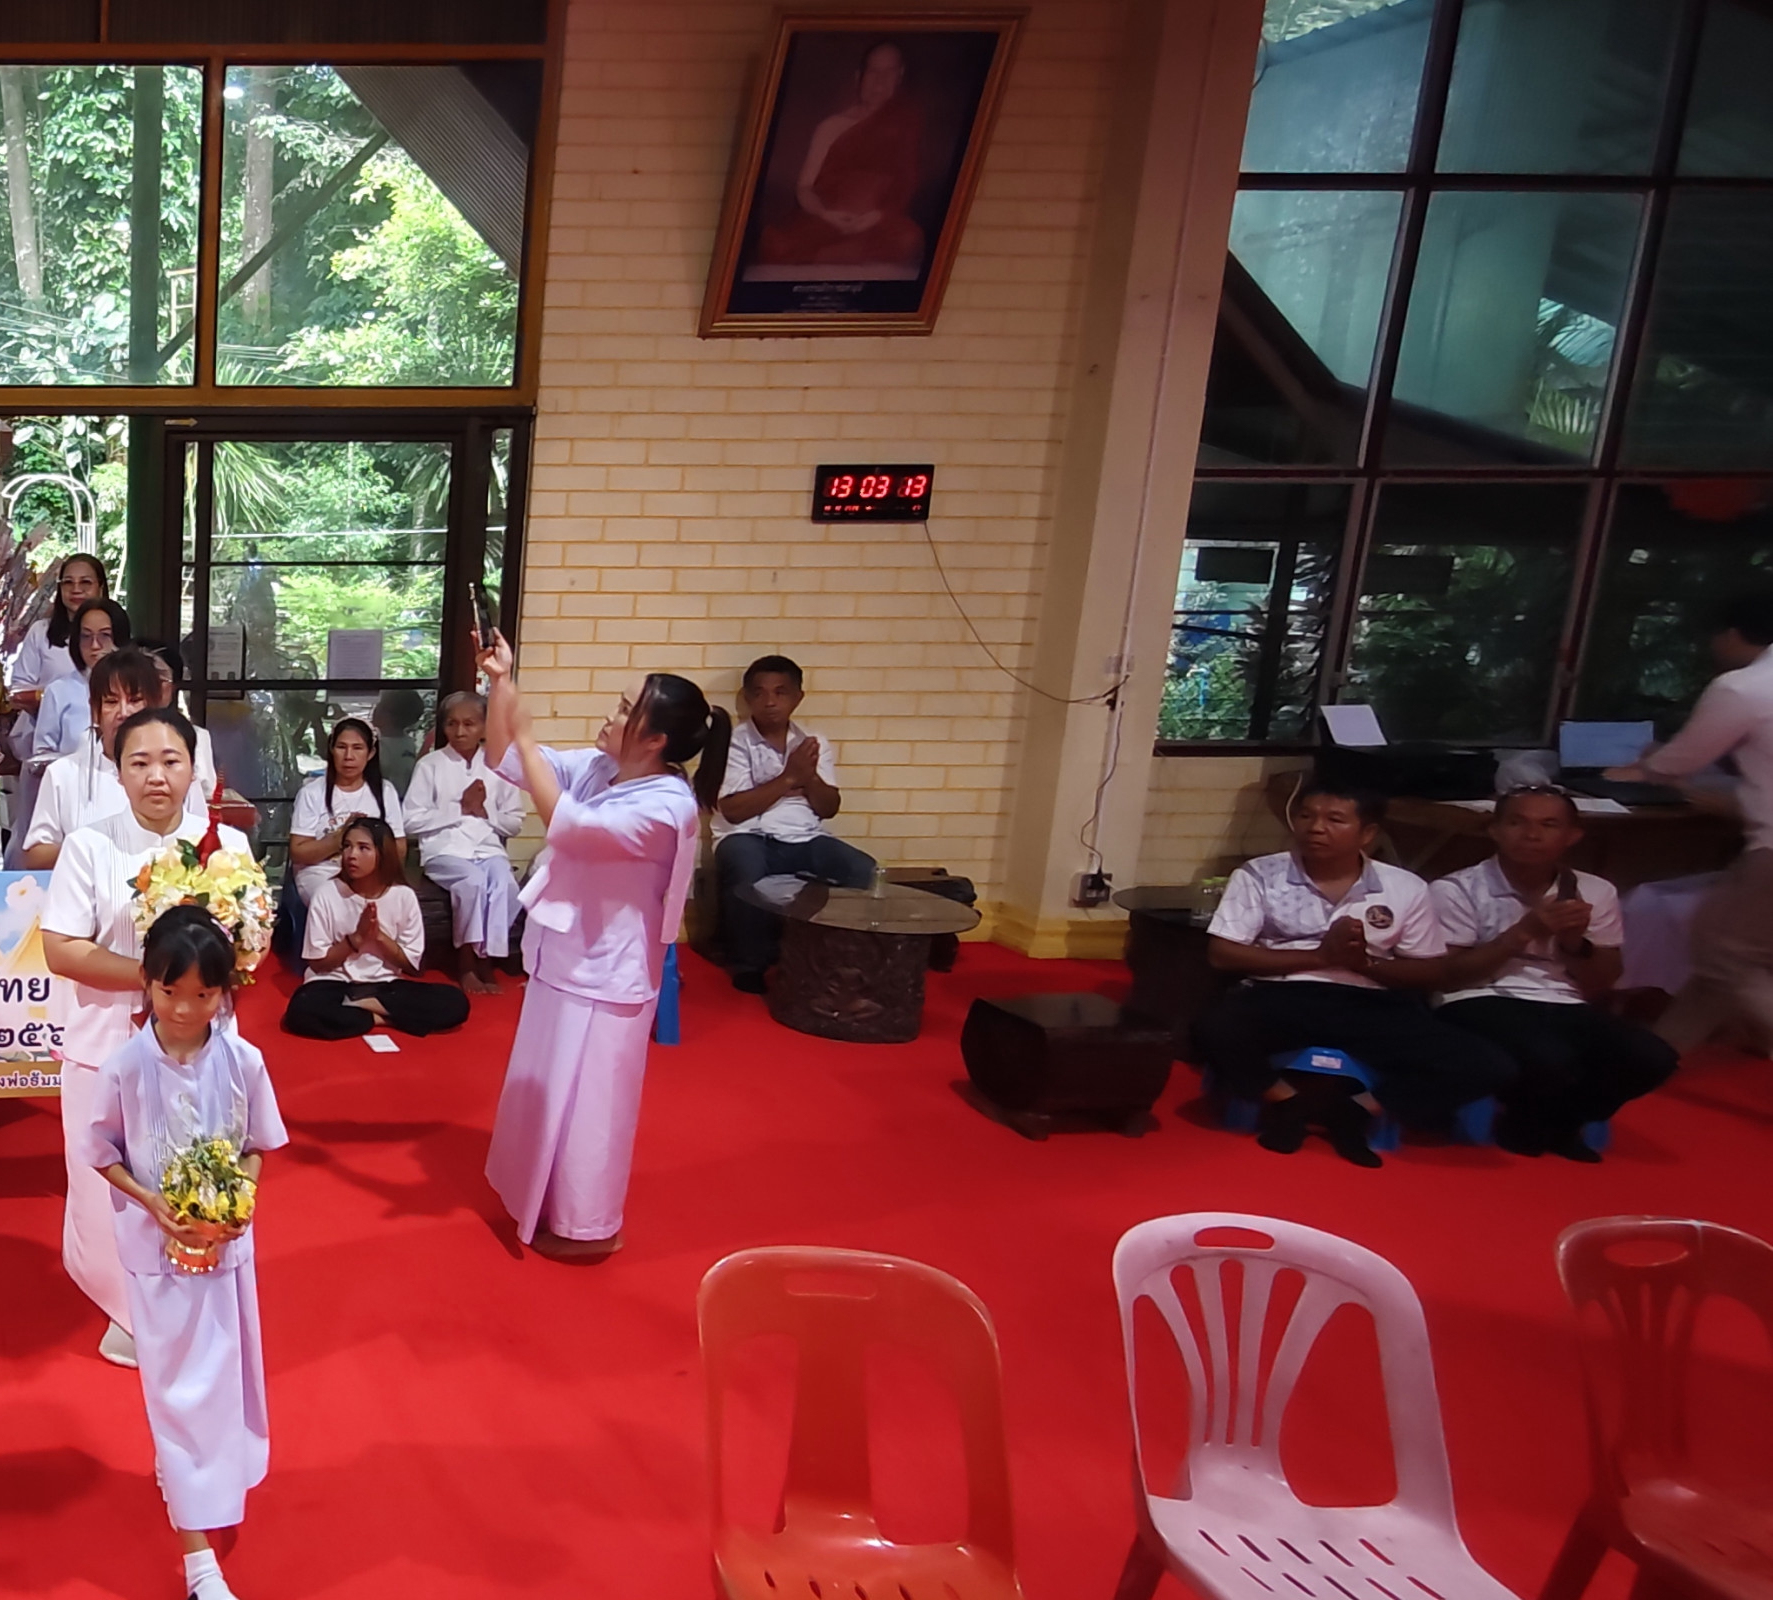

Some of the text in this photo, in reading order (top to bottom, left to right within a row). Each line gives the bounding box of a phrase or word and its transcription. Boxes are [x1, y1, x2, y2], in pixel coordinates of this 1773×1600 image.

[830, 475, 928, 499] 13 03 13
